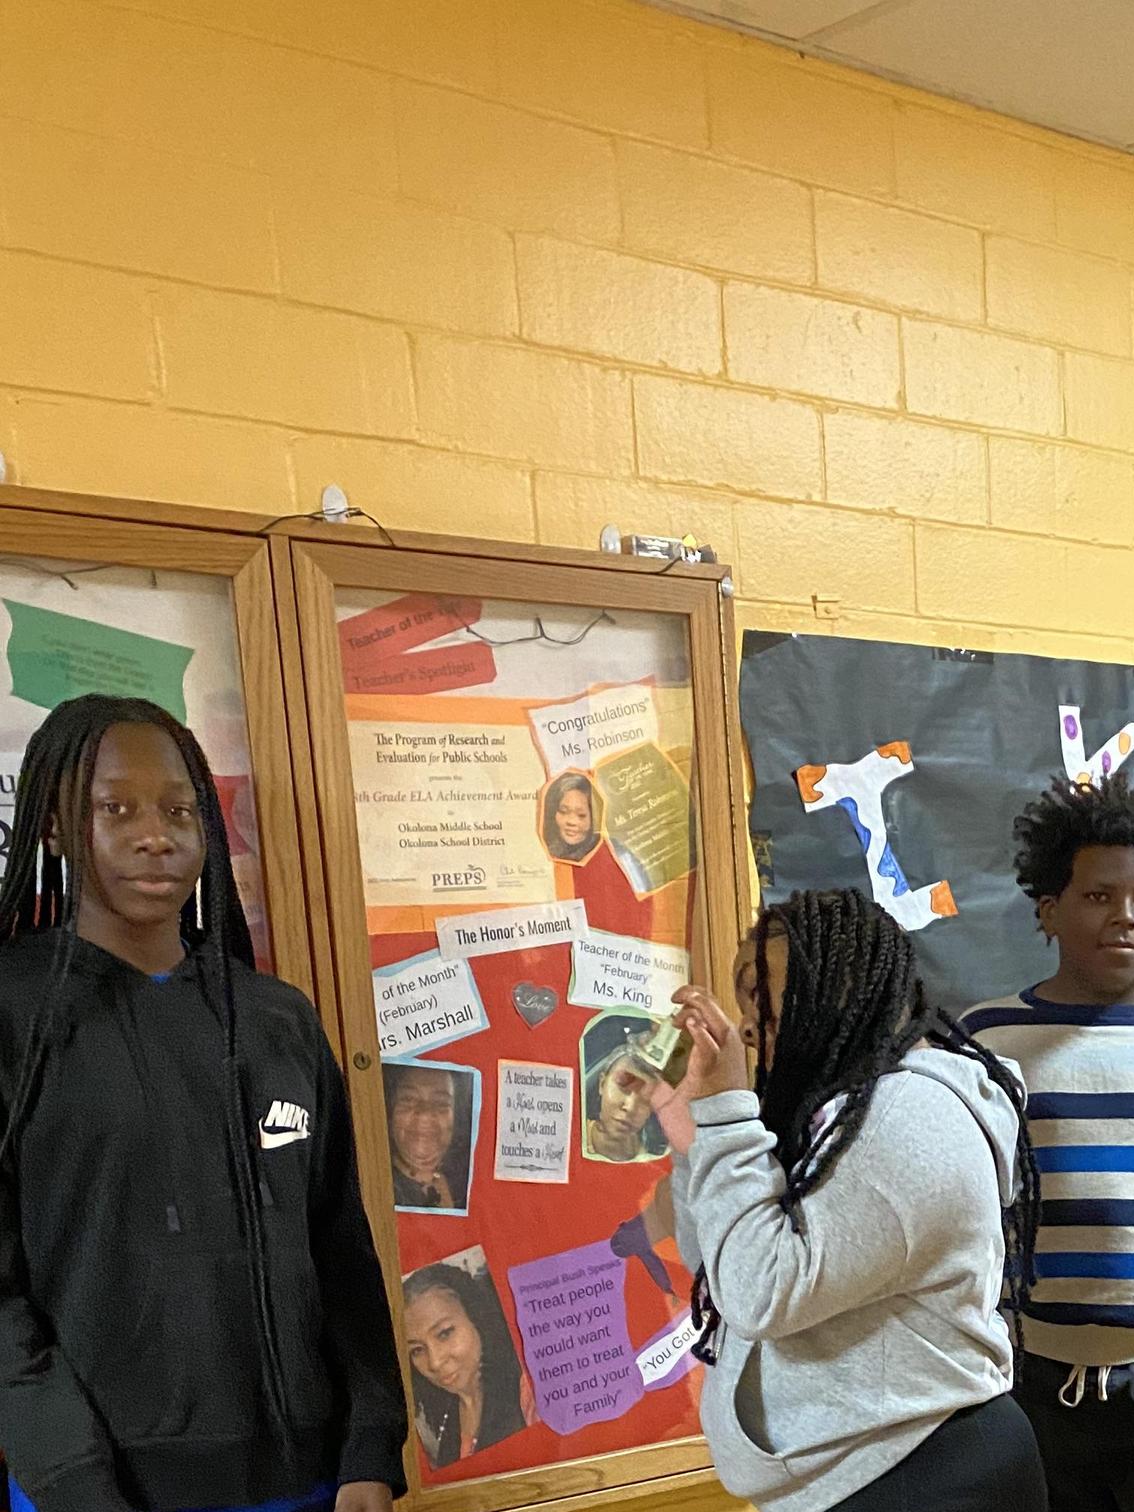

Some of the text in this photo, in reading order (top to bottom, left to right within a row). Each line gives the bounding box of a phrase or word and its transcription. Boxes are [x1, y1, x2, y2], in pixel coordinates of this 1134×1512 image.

[346, 611, 433, 650] Teacher of the
[375, 733, 506, 748] The Program of Research and
[561, 727, 644, 757] Ms. Robinson
[376, 751, 508, 766] Evaluation for Public Schools
[373, 790, 406, 802] Grade
[410, 791, 433, 802] ELA
[436, 790, 503, 802] Achievement
[506, 789, 538, 801] Award
[398, 821, 503, 833] Okolona Middle School
[399, 836, 505, 849] Okolona School District
[432, 872, 482, 887] PREPS
[454, 917, 572, 945] The Honor's Moment
[578, 940, 619, 960] Teacher
[621, 951, 633, 962] of
[634, 953, 651, 967] the
[382, 985, 394, 1000] of
[396, 980, 416, 996] the
[519, 993, 552, 1011] Love
[593, 980, 653, 1008] Ms. King
[379, 994, 438, 1026] (February)
[379, 1004, 474, 1052] rs. Marshall
[505, 1069, 567, 1089] A teacher takes
[506, 1096, 512, 1108] a
[536, 1100, 564, 1114] opens
[509, 1121, 515, 1133] a
[539, 1120, 557, 1136] and
[501, 1142, 534, 1158] touches
[535, 1148, 541, 1159] a
[519, 1275, 560, 1294] Principal
[561, 1269, 586, 1283] Bush
[568, 1278, 615, 1306] people
[528, 1304, 611, 1338] the way you
[533, 1326, 611, 1360] would want
[672, 1327, 695, 1349] Got
[538, 1344, 625, 1382] them to treat
[543, 1365, 630, 1408] you and your
[573, 1389, 622, 1416] Family"
